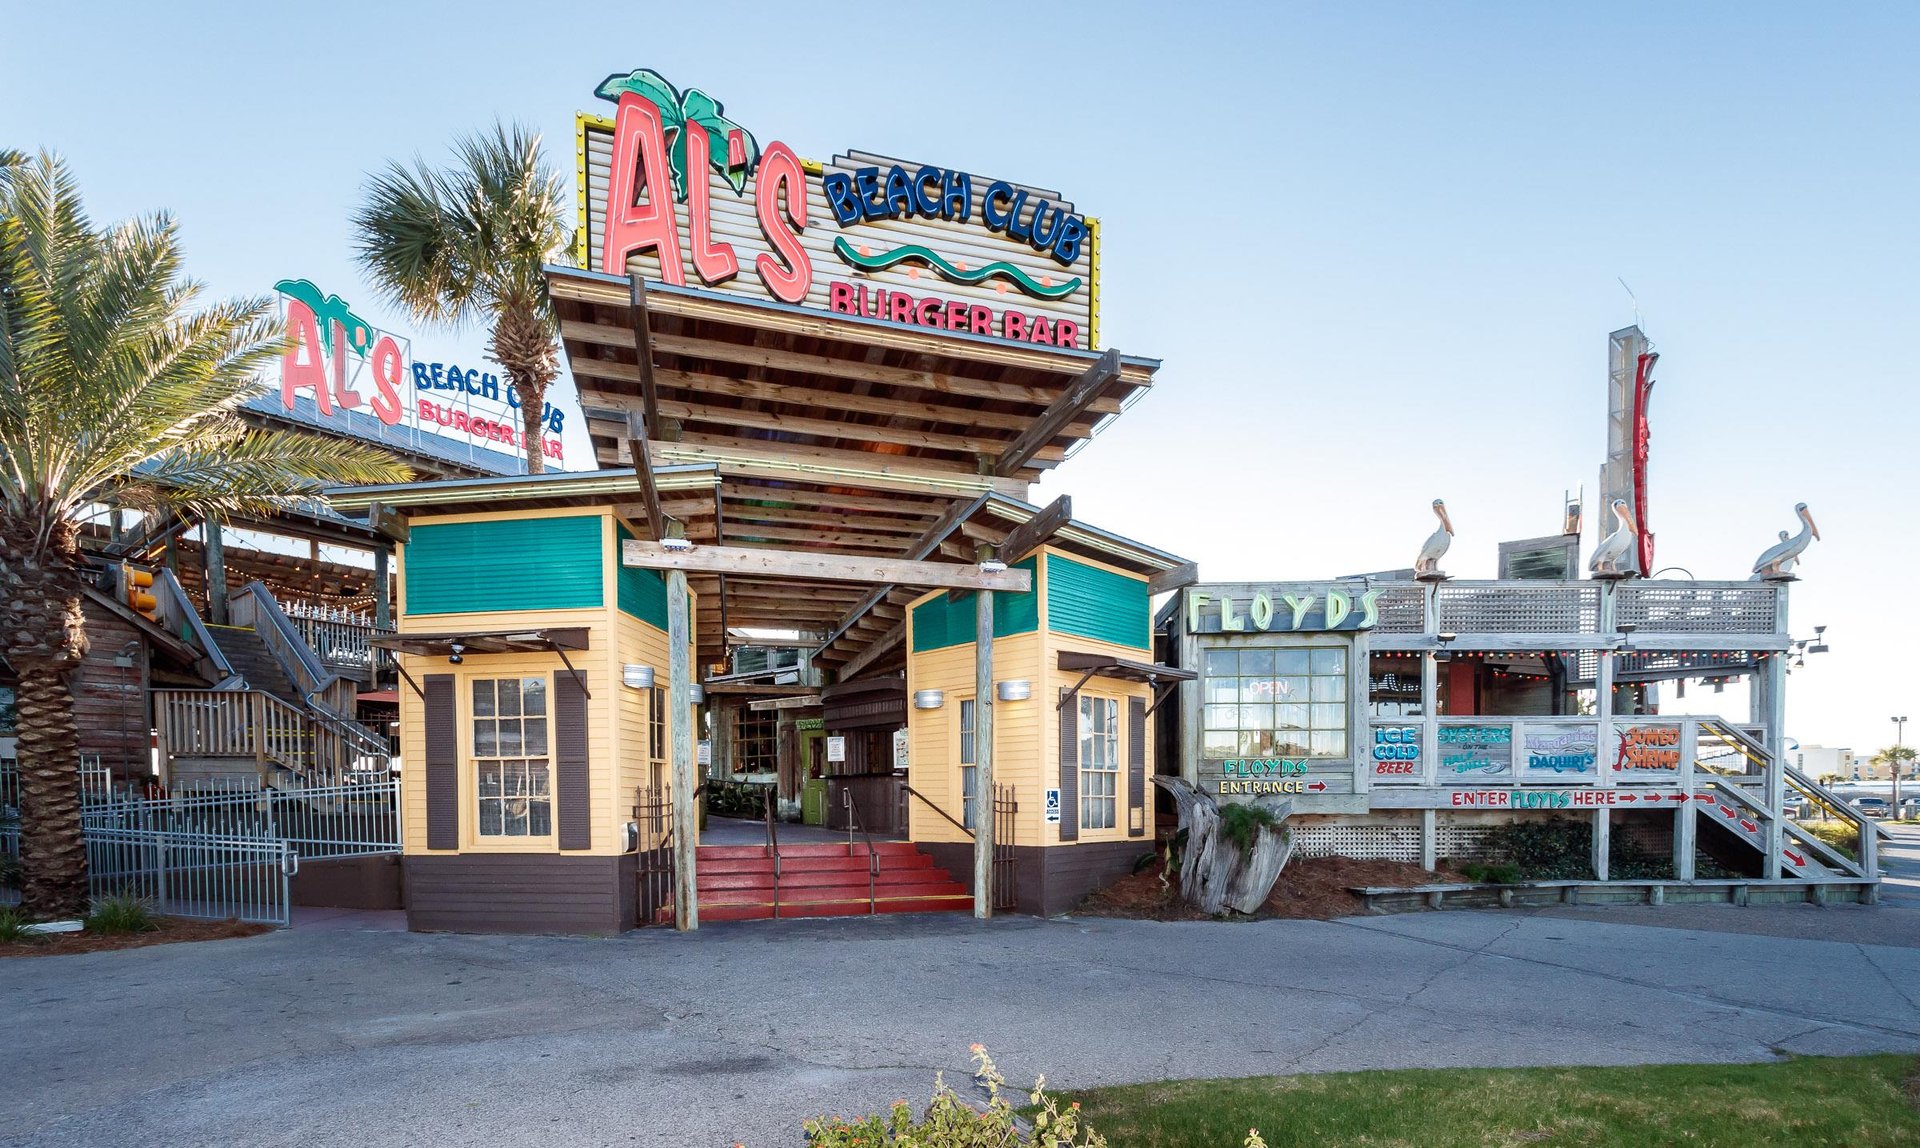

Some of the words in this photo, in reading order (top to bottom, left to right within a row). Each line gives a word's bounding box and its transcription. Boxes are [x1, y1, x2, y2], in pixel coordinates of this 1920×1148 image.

[602, 91, 812, 304] AL'S
[822, 165, 972, 229] BEACH
[981, 180, 1090, 267] CLUB
[829, 281, 994, 337] BURGER
[1002, 310, 1079, 350] BAR
[282, 299, 403, 426] AL'S
[412, 362, 499, 401] BEACH
[507, 385, 565, 434] CUB
[418, 398, 515, 446] BURGER
[1188, 587, 1387, 633] FLOYDS
[1249, 681, 1288, 695] OPEN
[1376, 727, 1416, 744] ICE
[1437, 727, 1512, 744] OYSTERS
[1625, 726, 1680, 746] JUMBO
[1373, 744, 1419, 760] COLD
[1443, 751, 1474, 767] HALF
[1624, 745, 1681, 770] SHRIMP
[1223, 759, 1309, 778] FLOYDS
[1376, 761, 1414, 775] BEER
[1456, 757, 1490, 774] SHELL
[1218, 780, 1304, 794] ENTRANCE
[1452, 791, 1508, 805] ENTER
[1510, 790, 1571, 808] FLOYDS
[1573, 791, 1616, 805] HERE
